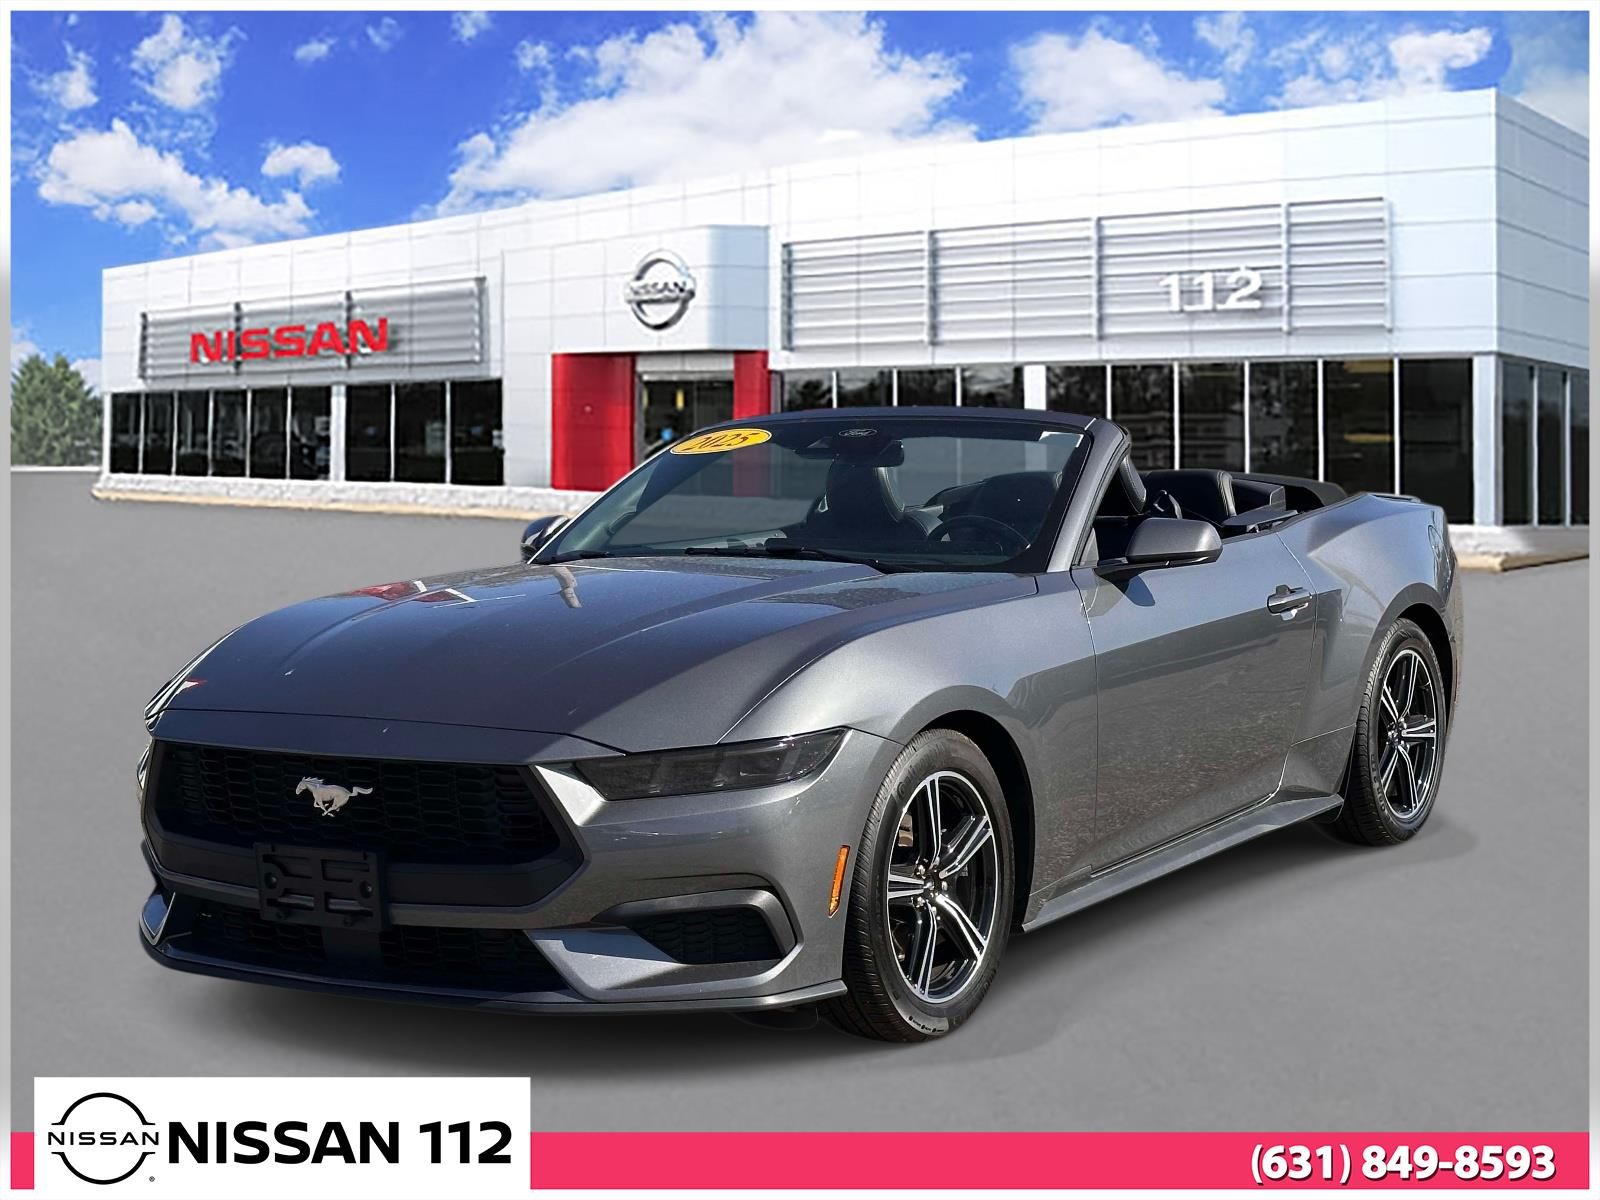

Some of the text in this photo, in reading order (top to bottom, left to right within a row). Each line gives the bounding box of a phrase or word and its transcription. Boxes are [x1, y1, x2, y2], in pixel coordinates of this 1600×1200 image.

[1159, 265, 1262, 313] 112
[190, 317, 388, 363] NISSAN
[681, 432, 761, 452] 2025
